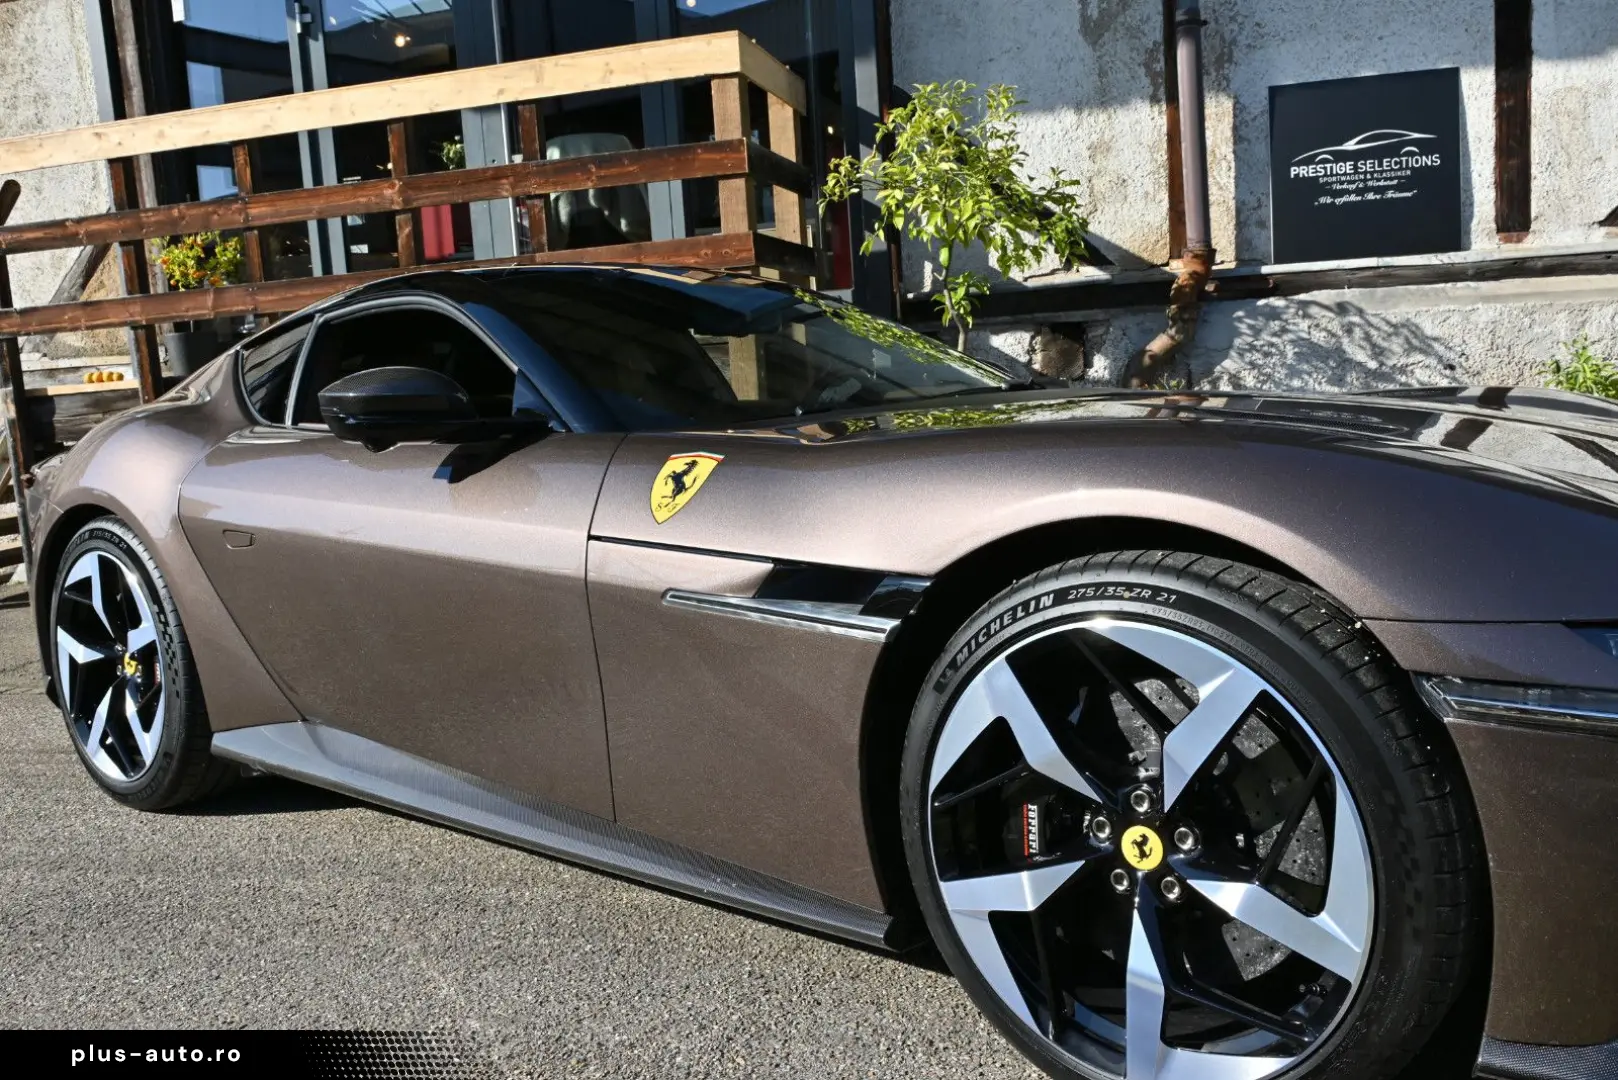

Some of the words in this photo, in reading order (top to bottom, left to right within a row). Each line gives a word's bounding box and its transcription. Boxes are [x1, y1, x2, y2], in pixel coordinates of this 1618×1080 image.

[1290, 161, 1354, 179] PRESTIGE
[1357, 154, 1441, 172] SELECTIONS
[1319, 174, 1365, 184] SPORTWAGEN
[1373, 170, 1411, 178] KLASSIKER
[1067, 586, 1126, 600] 275/35
[1130, 587, 1152, 598] ZR
[1156, 592, 1177, 603] 21
[956, 593, 1055, 667] MICHELIN
[1027, 803, 1039, 854] Ferrari
